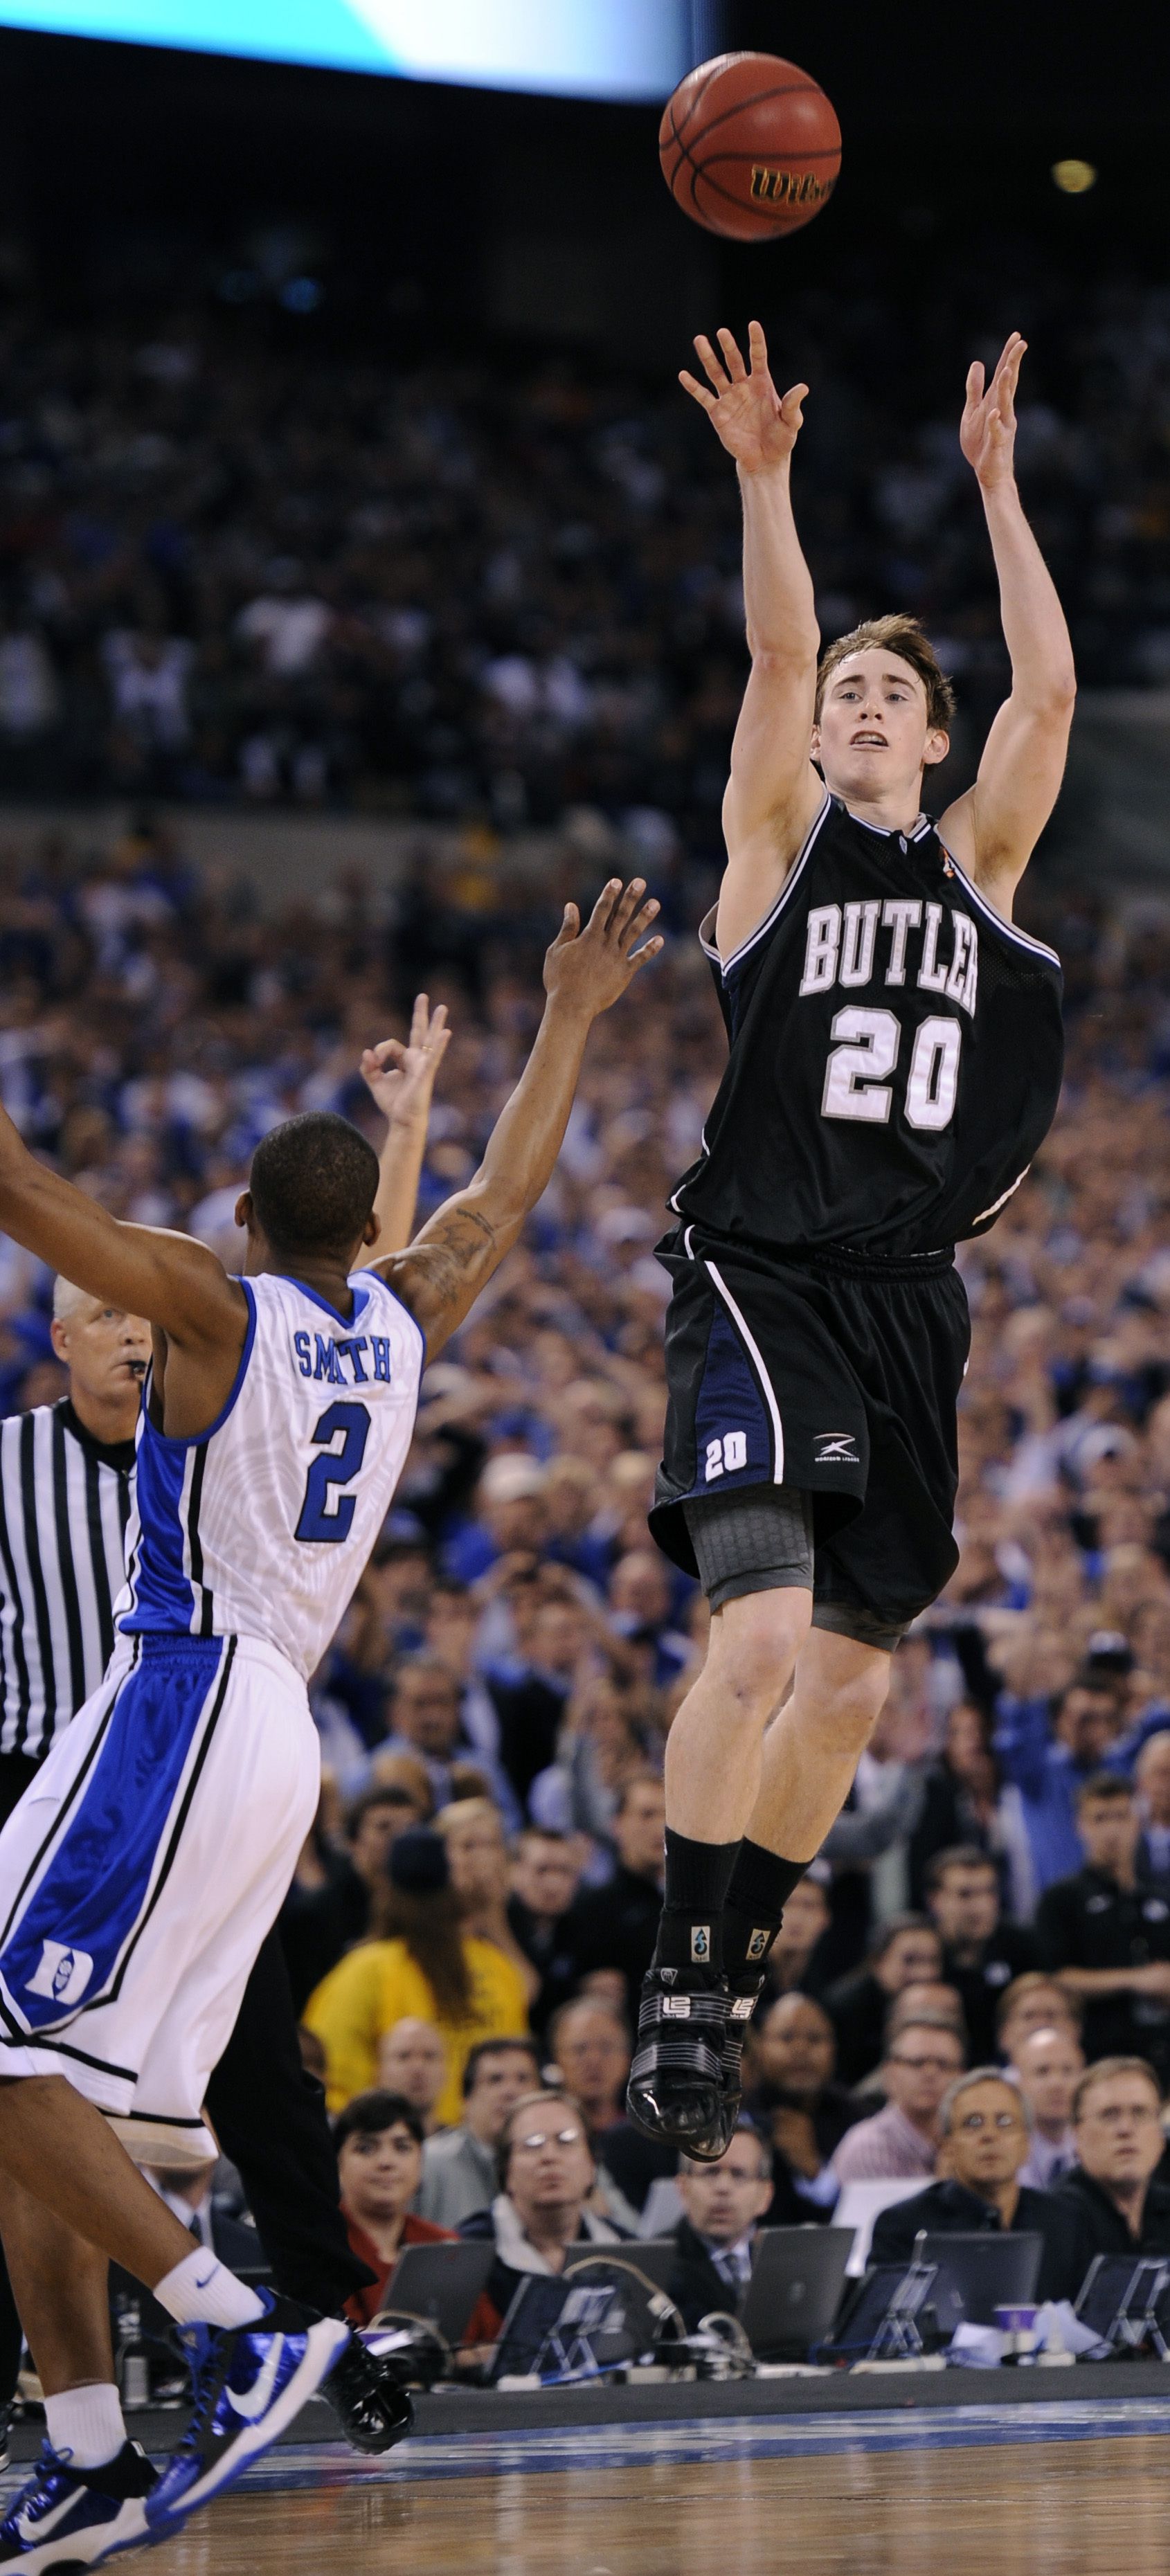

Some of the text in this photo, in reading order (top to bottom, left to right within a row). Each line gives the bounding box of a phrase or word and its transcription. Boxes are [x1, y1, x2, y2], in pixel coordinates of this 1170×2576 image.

[821, 1005, 962, 1131] 20
[294, 1401, 371, 1542] 2
[705, 1431, 747, 1483] 20
